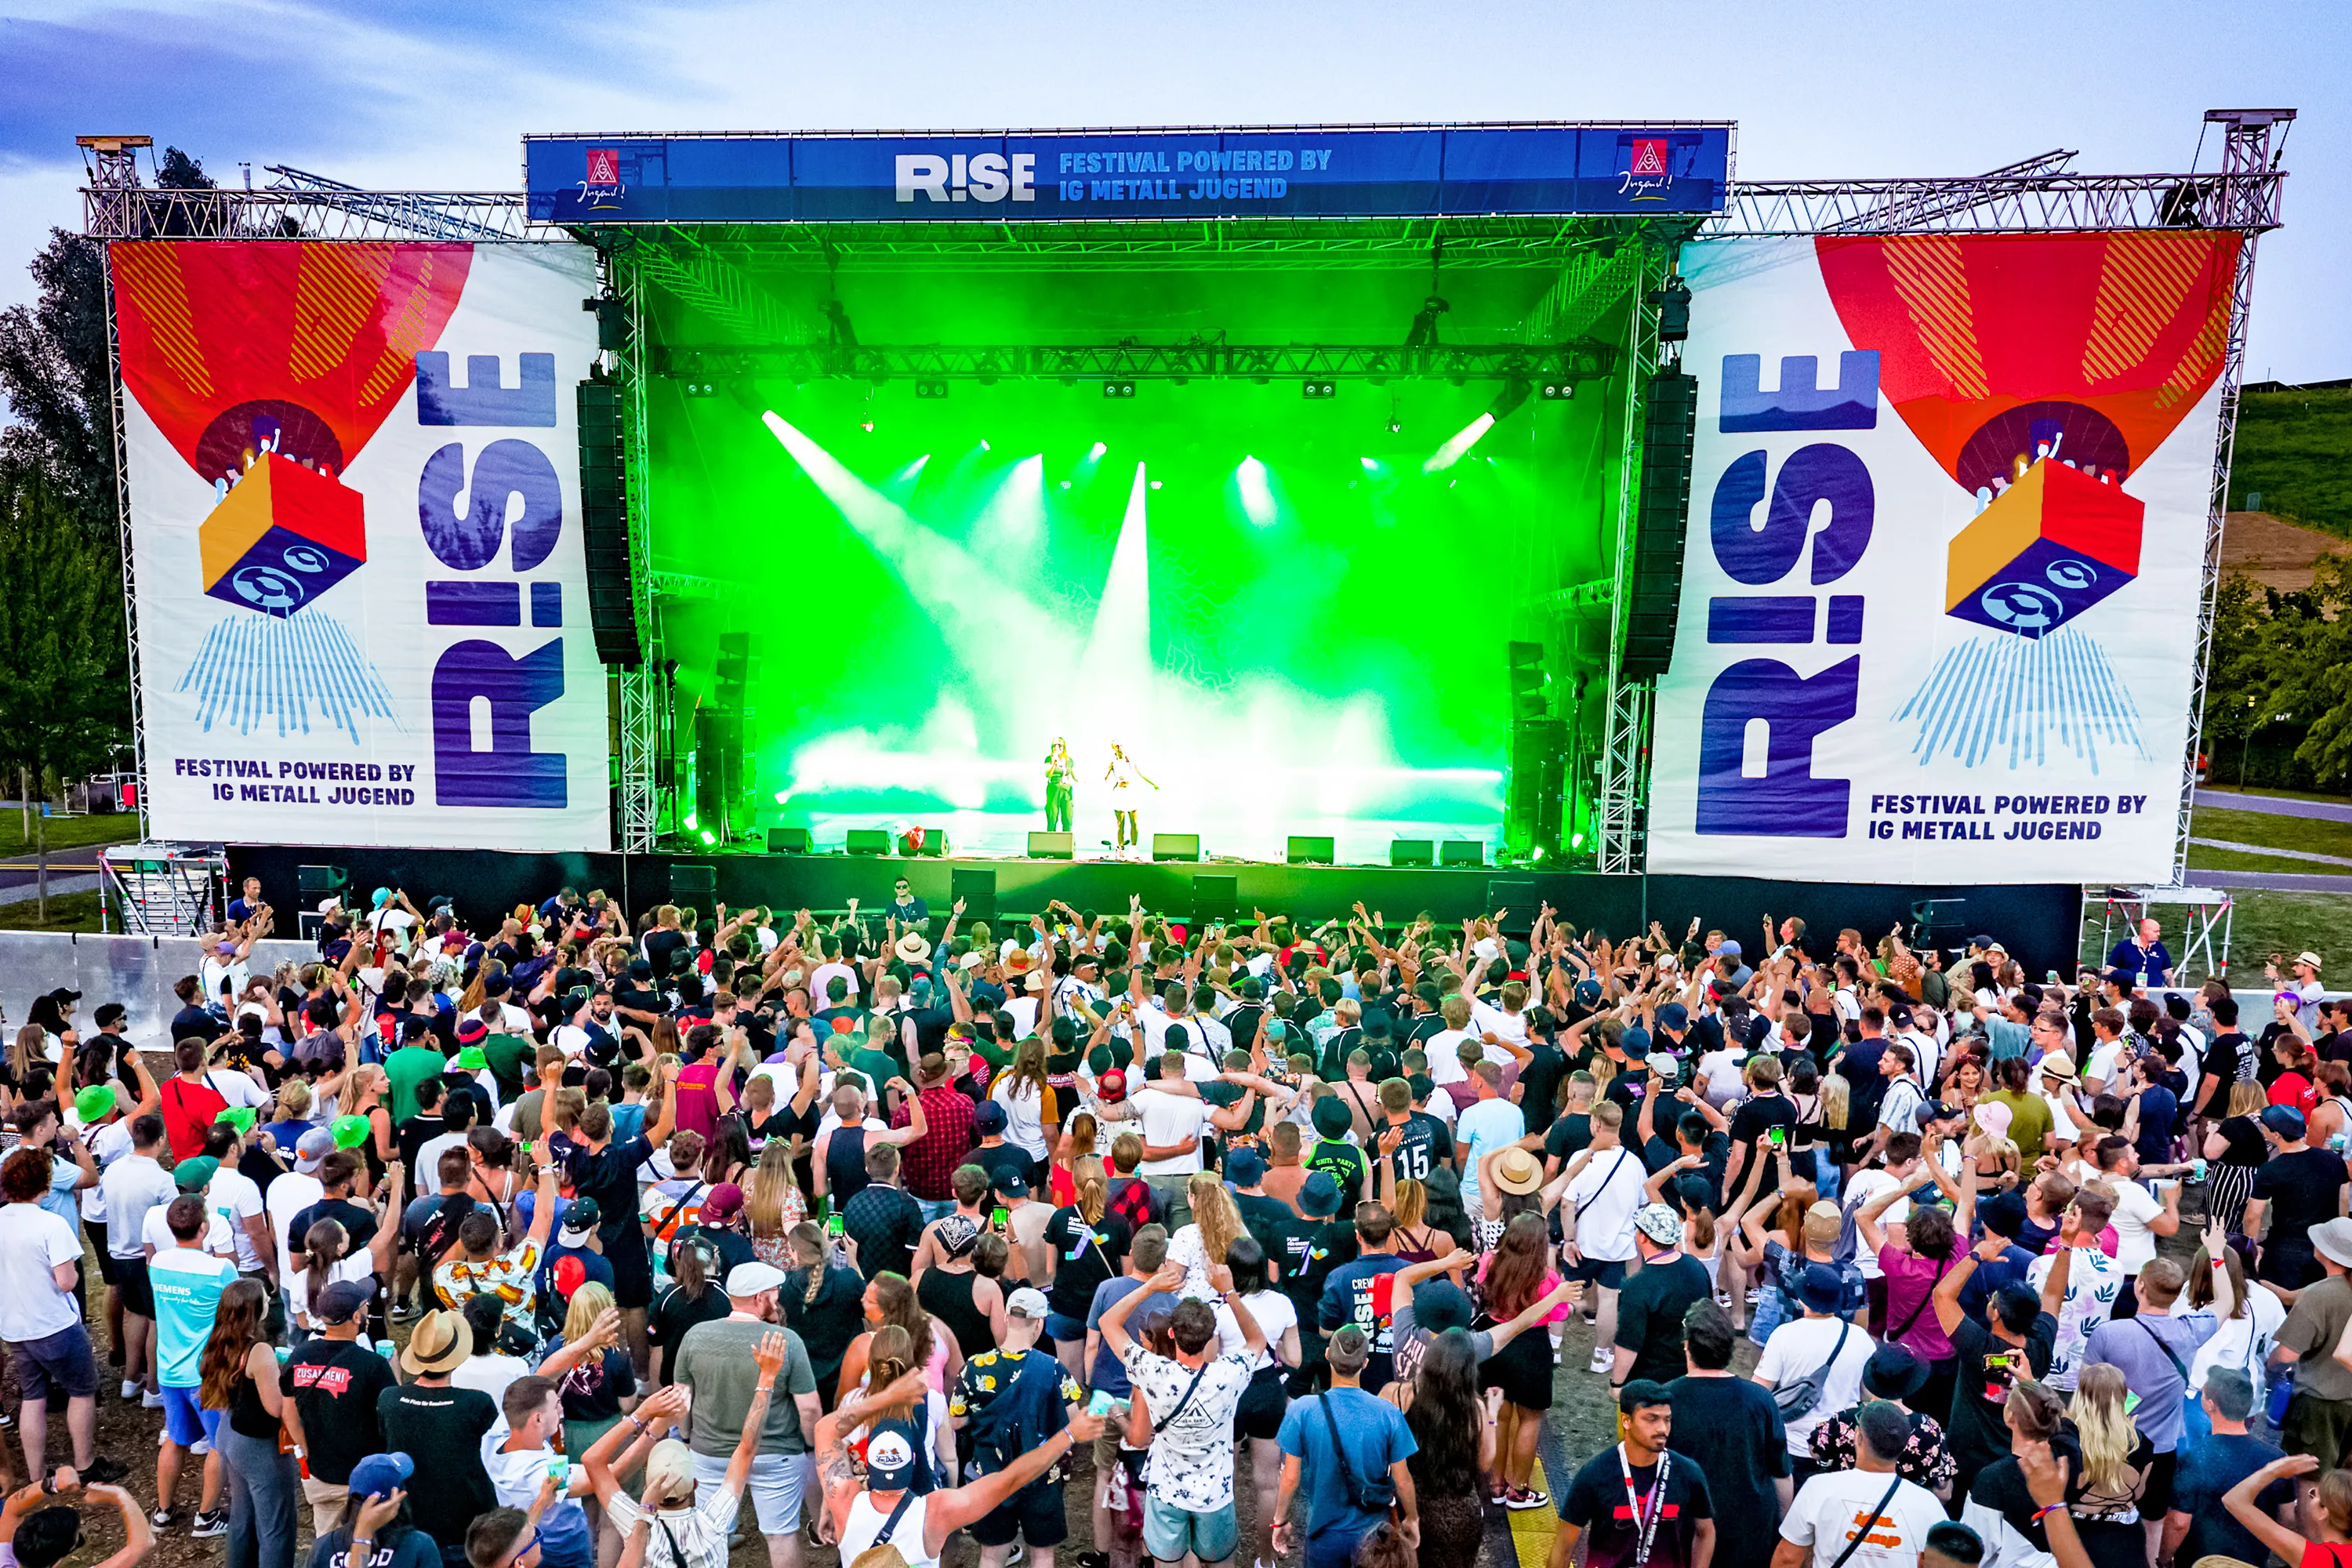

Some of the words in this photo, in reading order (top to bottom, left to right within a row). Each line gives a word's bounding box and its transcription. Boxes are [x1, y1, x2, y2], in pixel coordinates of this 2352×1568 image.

[1060, 152, 1170, 173] FESTIVAL
[1178, 151, 1293, 172] POWERED
[1301, 150, 1332, 170] BY
[1060, 180, 1083, 201] IG
[1091, 180, 1181, 200] METALL
[1189, 178, 1287, 199] JUGEND
[175, 758, 273, 779] FESTIVAL
[279, 761, 381, 781] POWERED
[388, 764, 415, 782] BY
[212, 783, 234, 801] IG
[241, 784, 320, 804] METALL
[328, 786, 415, 806] JUGEND
[1871, 795, 1986, 815] FESTIVAL
[1994, 795, 2110, 815] POWERED
[2117, 795, 2147, 814] BY
[1868, 820, 1894, 840] IG
[1902, 821, 1994, 840] METALL
[2003, 821, 2101, 840] JUGEND
[1397, 1143, 1428, 1180] 15
[1352, 1277, 1374, 1290] CREW
[1845, 1530, 1902, 1549] cmp
